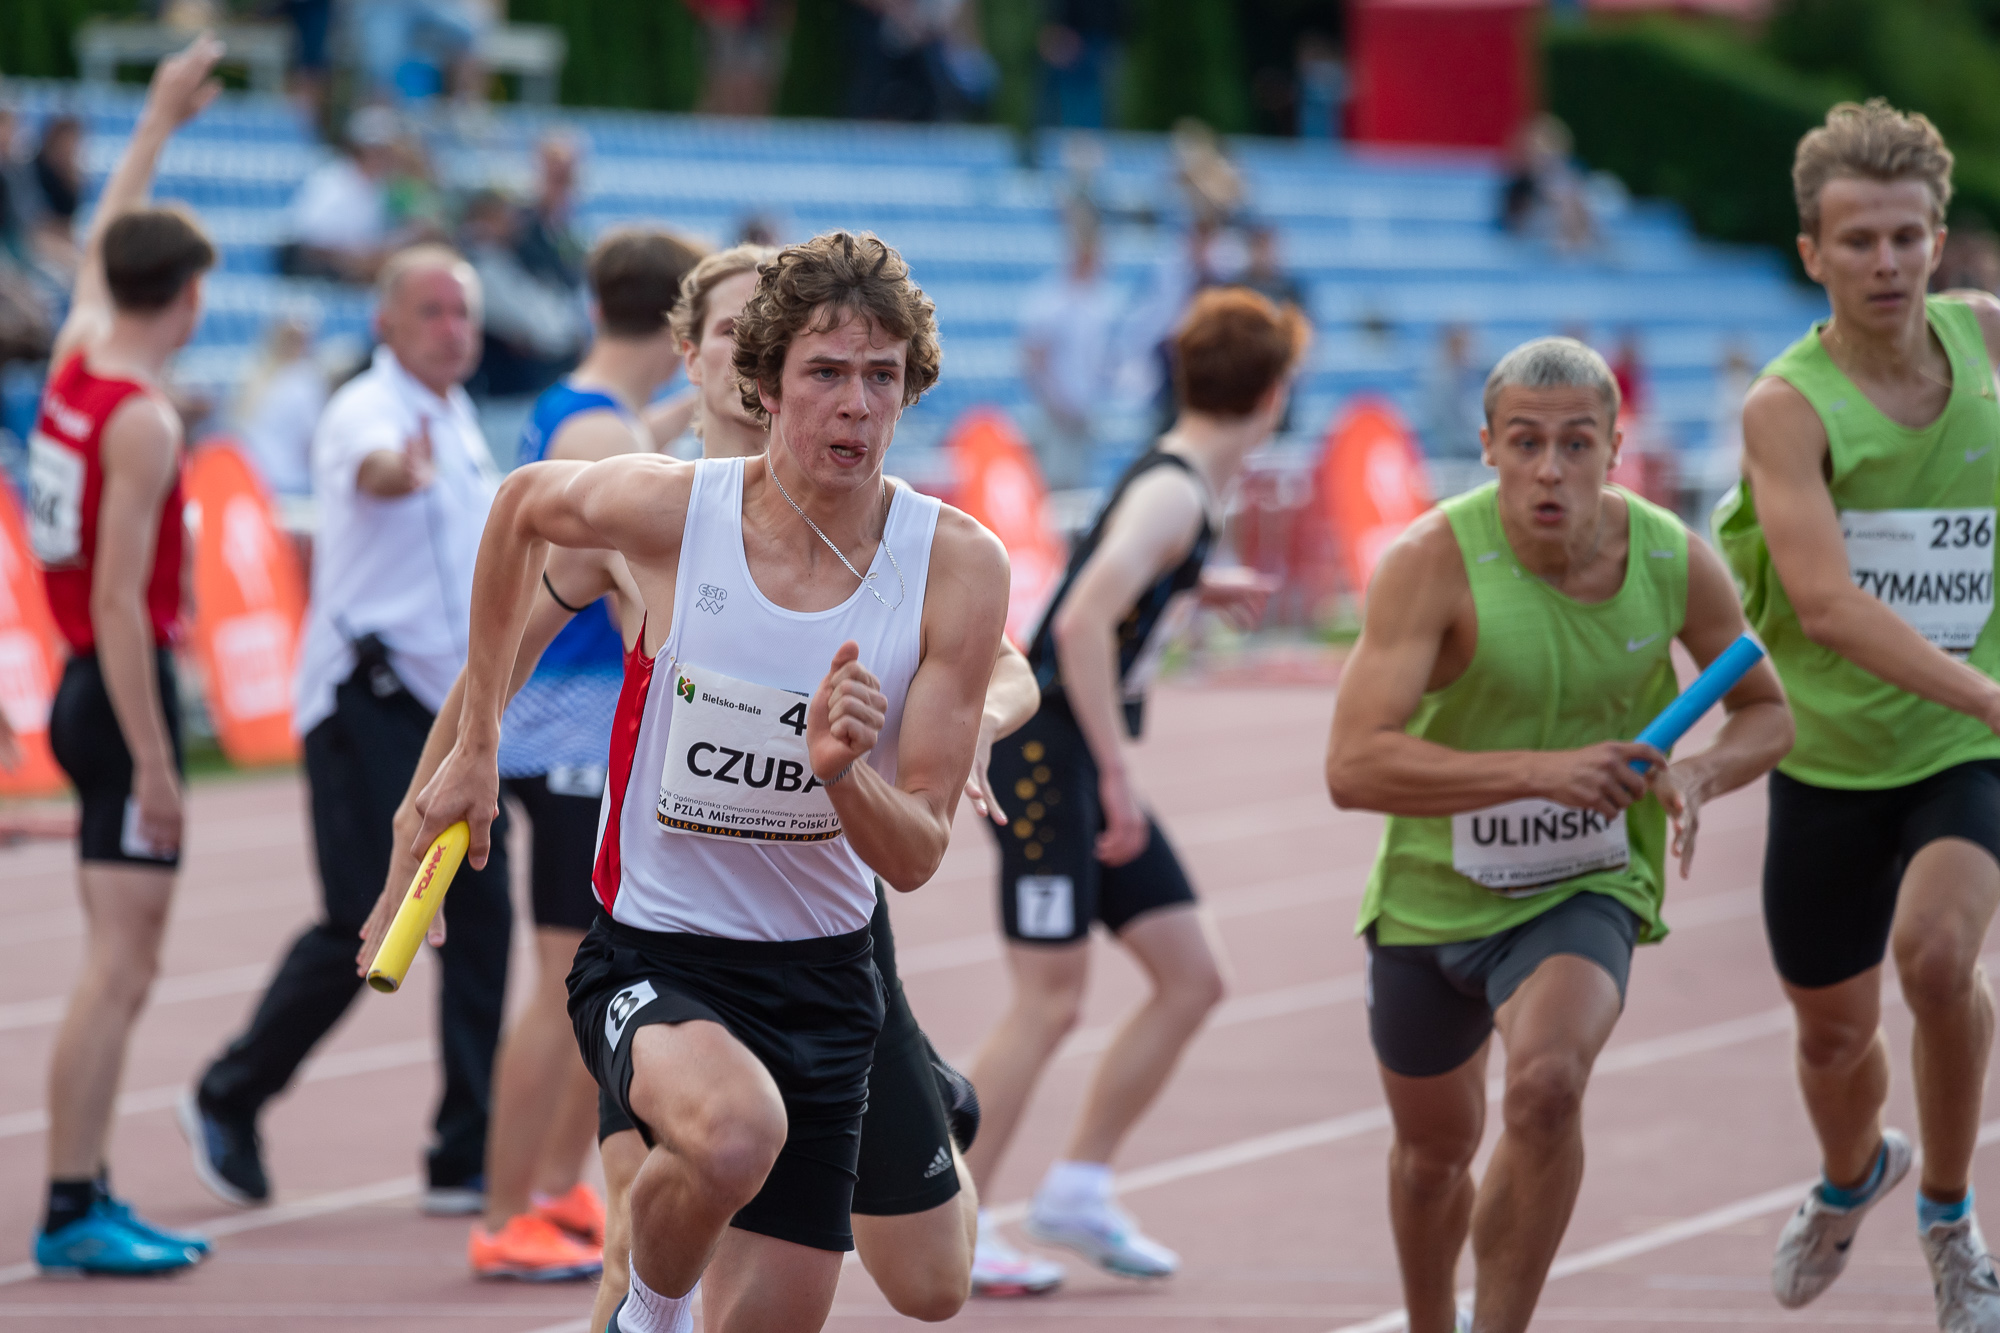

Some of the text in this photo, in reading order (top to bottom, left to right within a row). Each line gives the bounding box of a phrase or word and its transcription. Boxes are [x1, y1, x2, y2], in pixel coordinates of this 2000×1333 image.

[1931, 516, 1992, 549] 236
[702, 692, 762, 715] Bielsko-Biała
[672, 793, 721, 809] Ogólnopolska
[722, 804, 760, 815] Olimpiada
[673, 802, 704, 819] PZLA
[708, 810, 786, 828] Mistrzostwa
[789, 818, 829, 830] Polski
[609, 990, 640, 1032] 8
